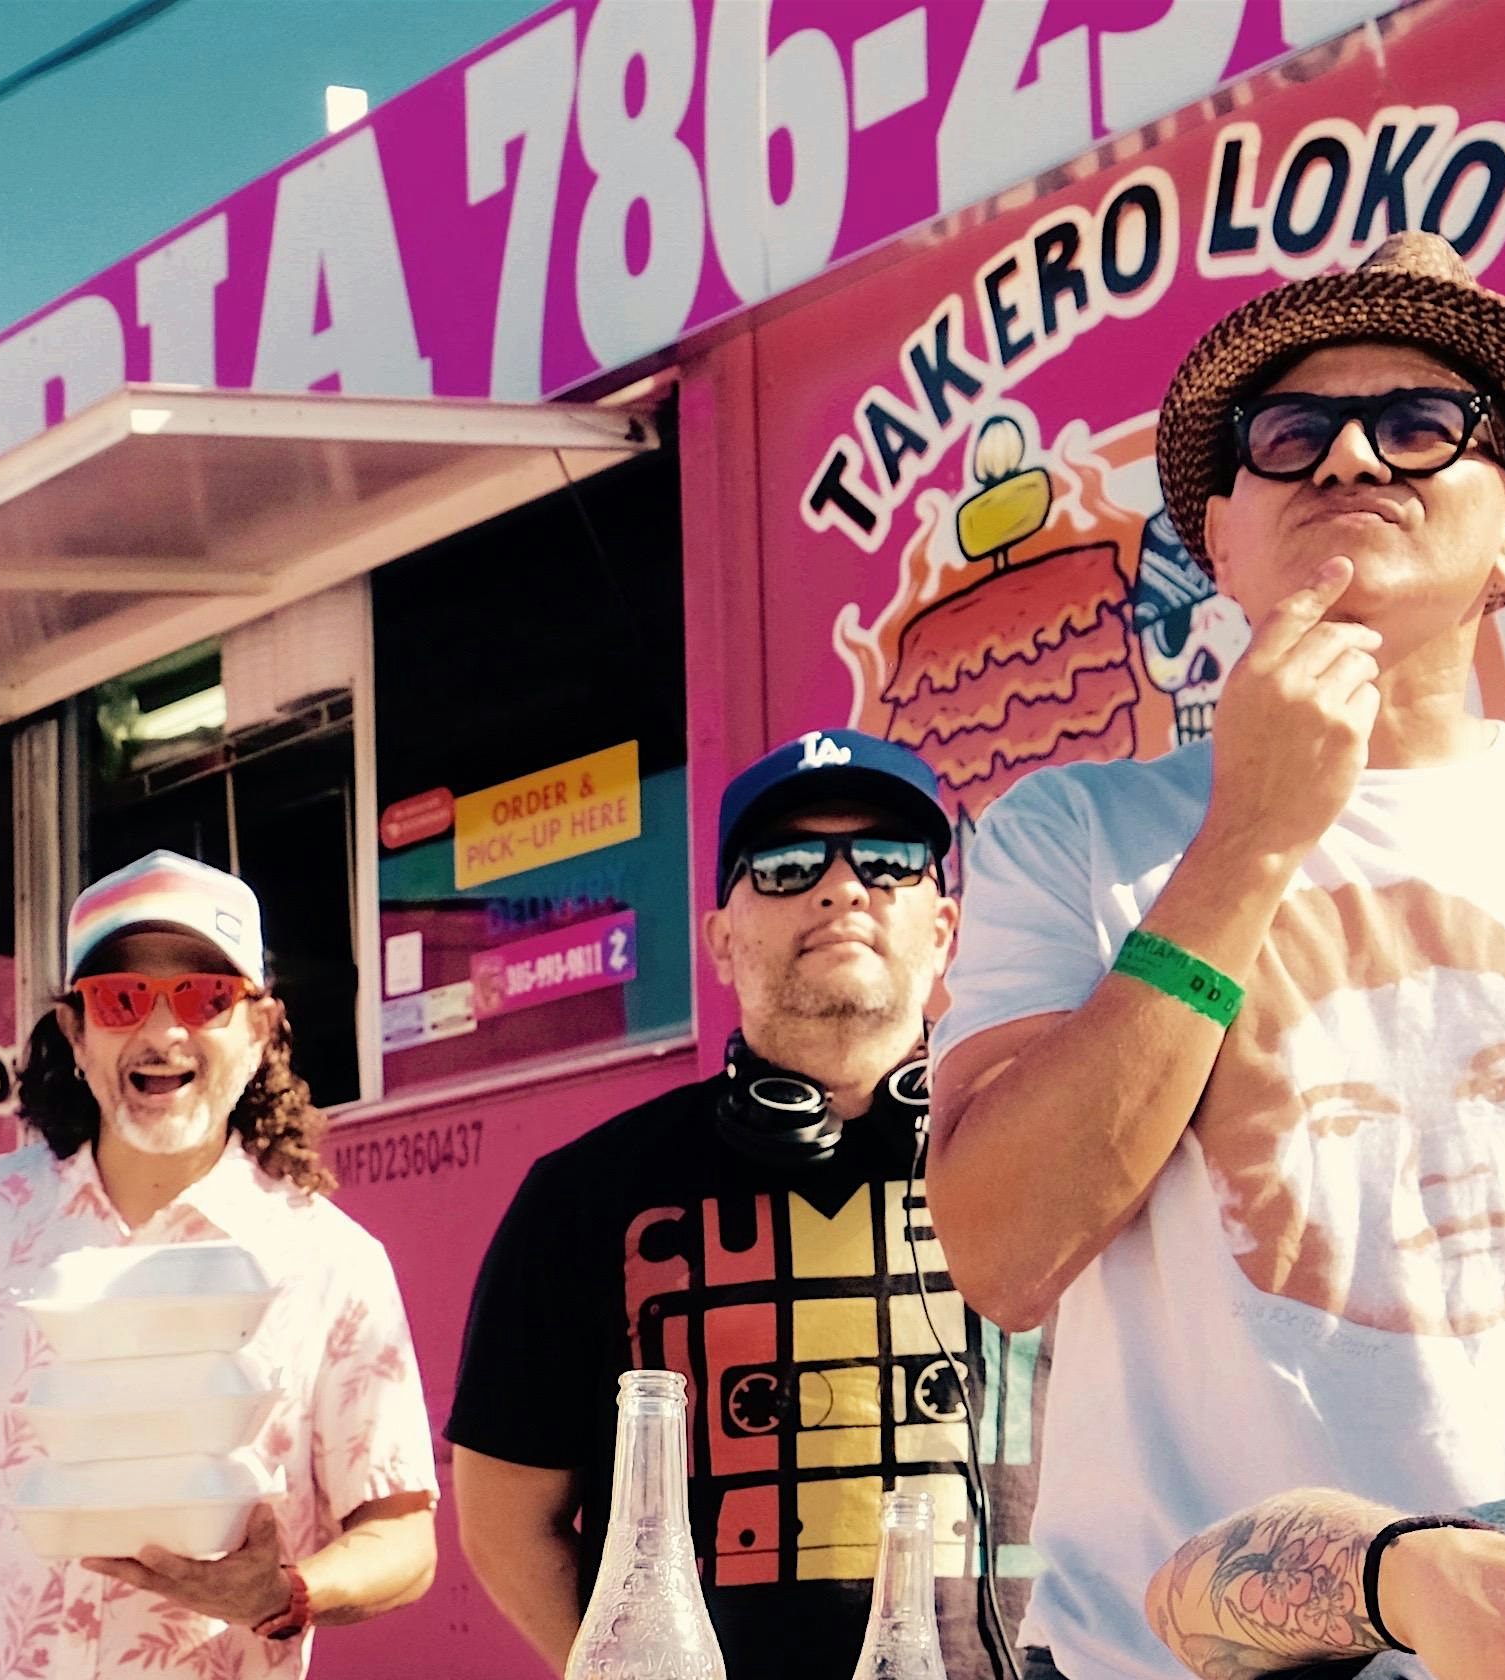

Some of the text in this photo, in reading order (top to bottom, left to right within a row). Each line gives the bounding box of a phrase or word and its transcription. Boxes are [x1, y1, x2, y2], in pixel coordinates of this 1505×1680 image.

[809, 181, 1167, 541] TAKERO
[466, 816, 562, 871] PICK-UP
[571, 797, 628, 838] HERE
[493, 780, 568, 827] ORDER
[578, 771, 596, 798] &
[336, 1119, 483, 1188] MFD2360437
